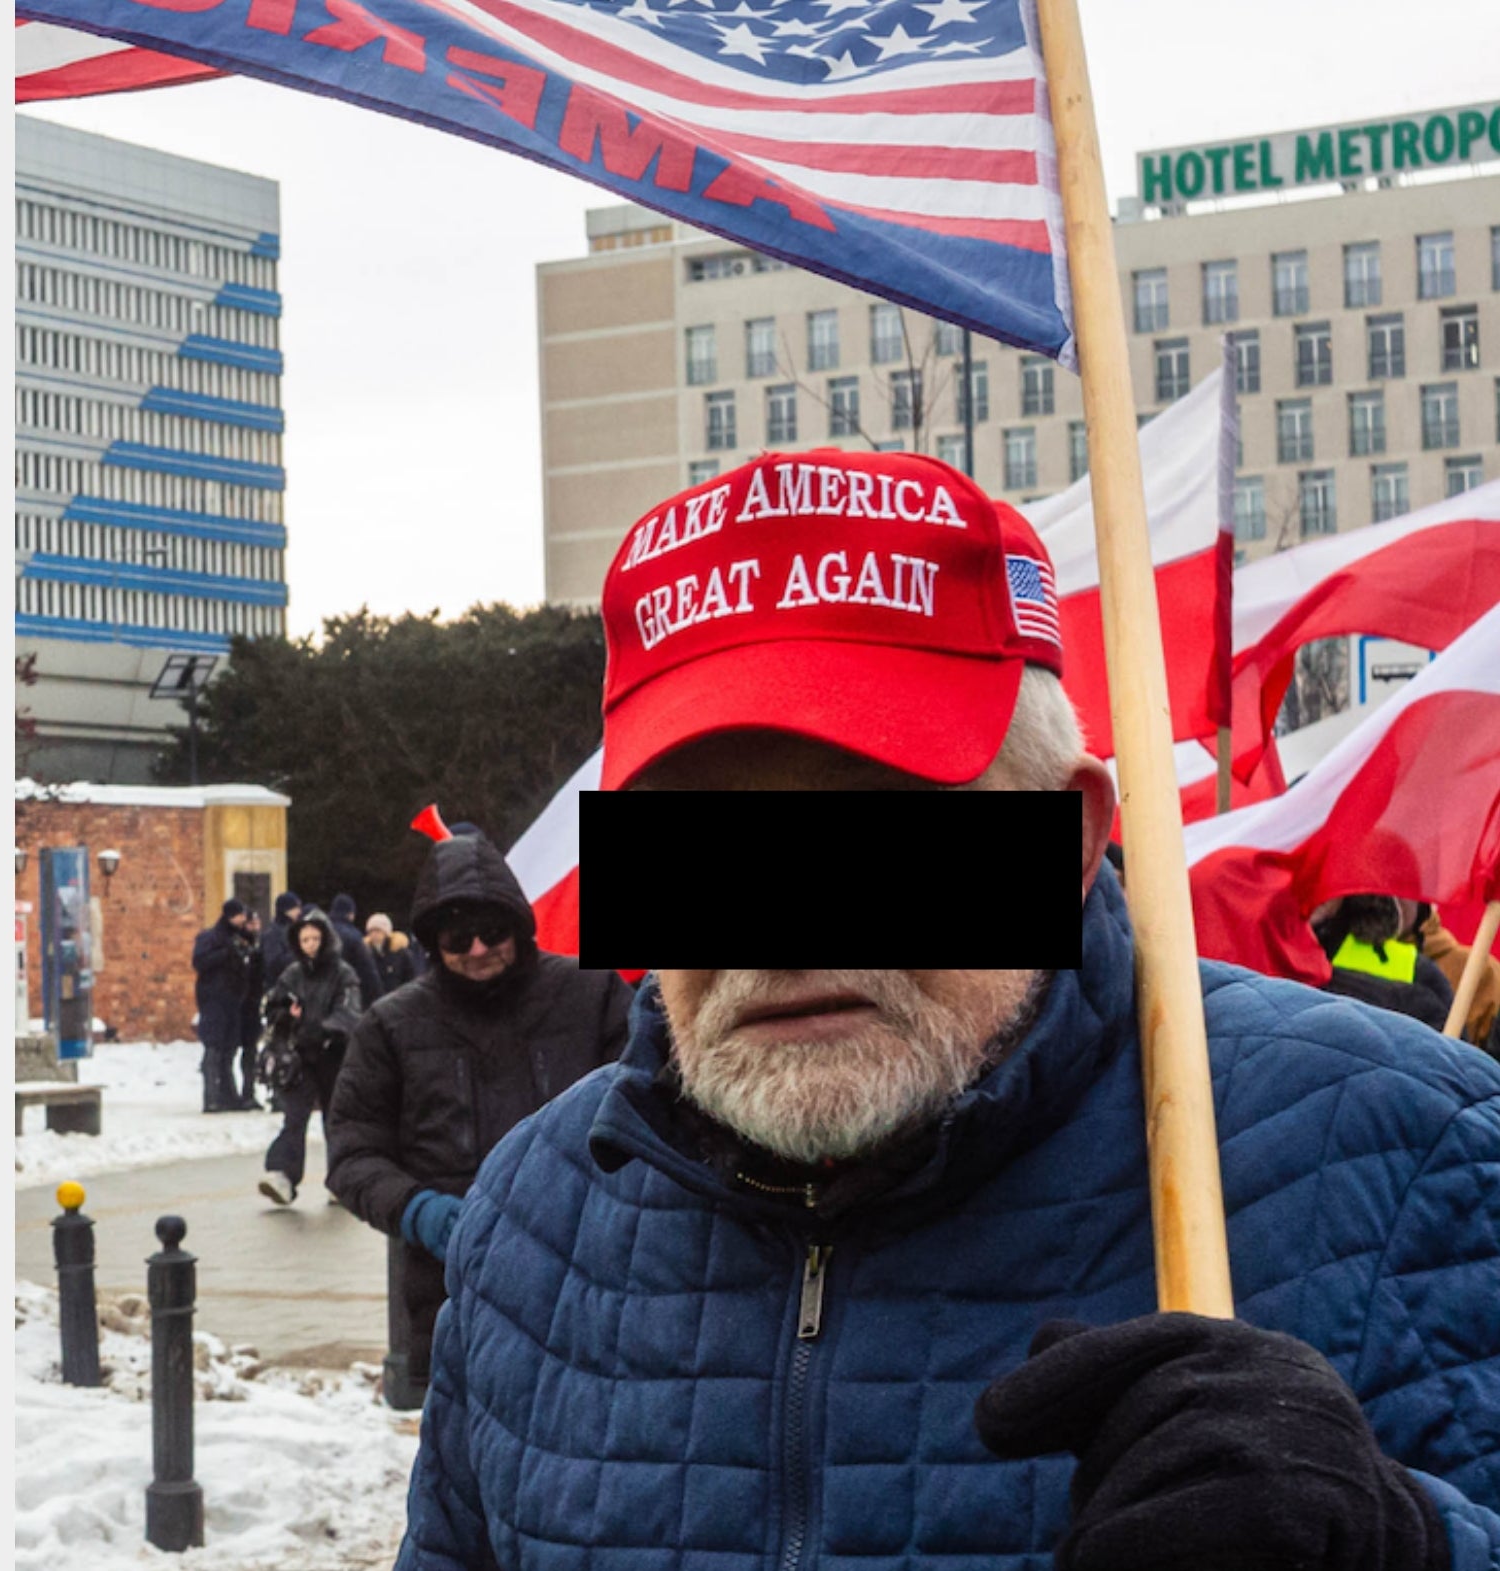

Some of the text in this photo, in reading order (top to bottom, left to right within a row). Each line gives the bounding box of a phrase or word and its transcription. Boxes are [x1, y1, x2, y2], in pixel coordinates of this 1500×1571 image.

[1142, 139, 1283, 203] HOTEL
[621, 463, 967, 572] MAKE AMERICA
[634, 550, 940, 651] GREAT AGAIN
